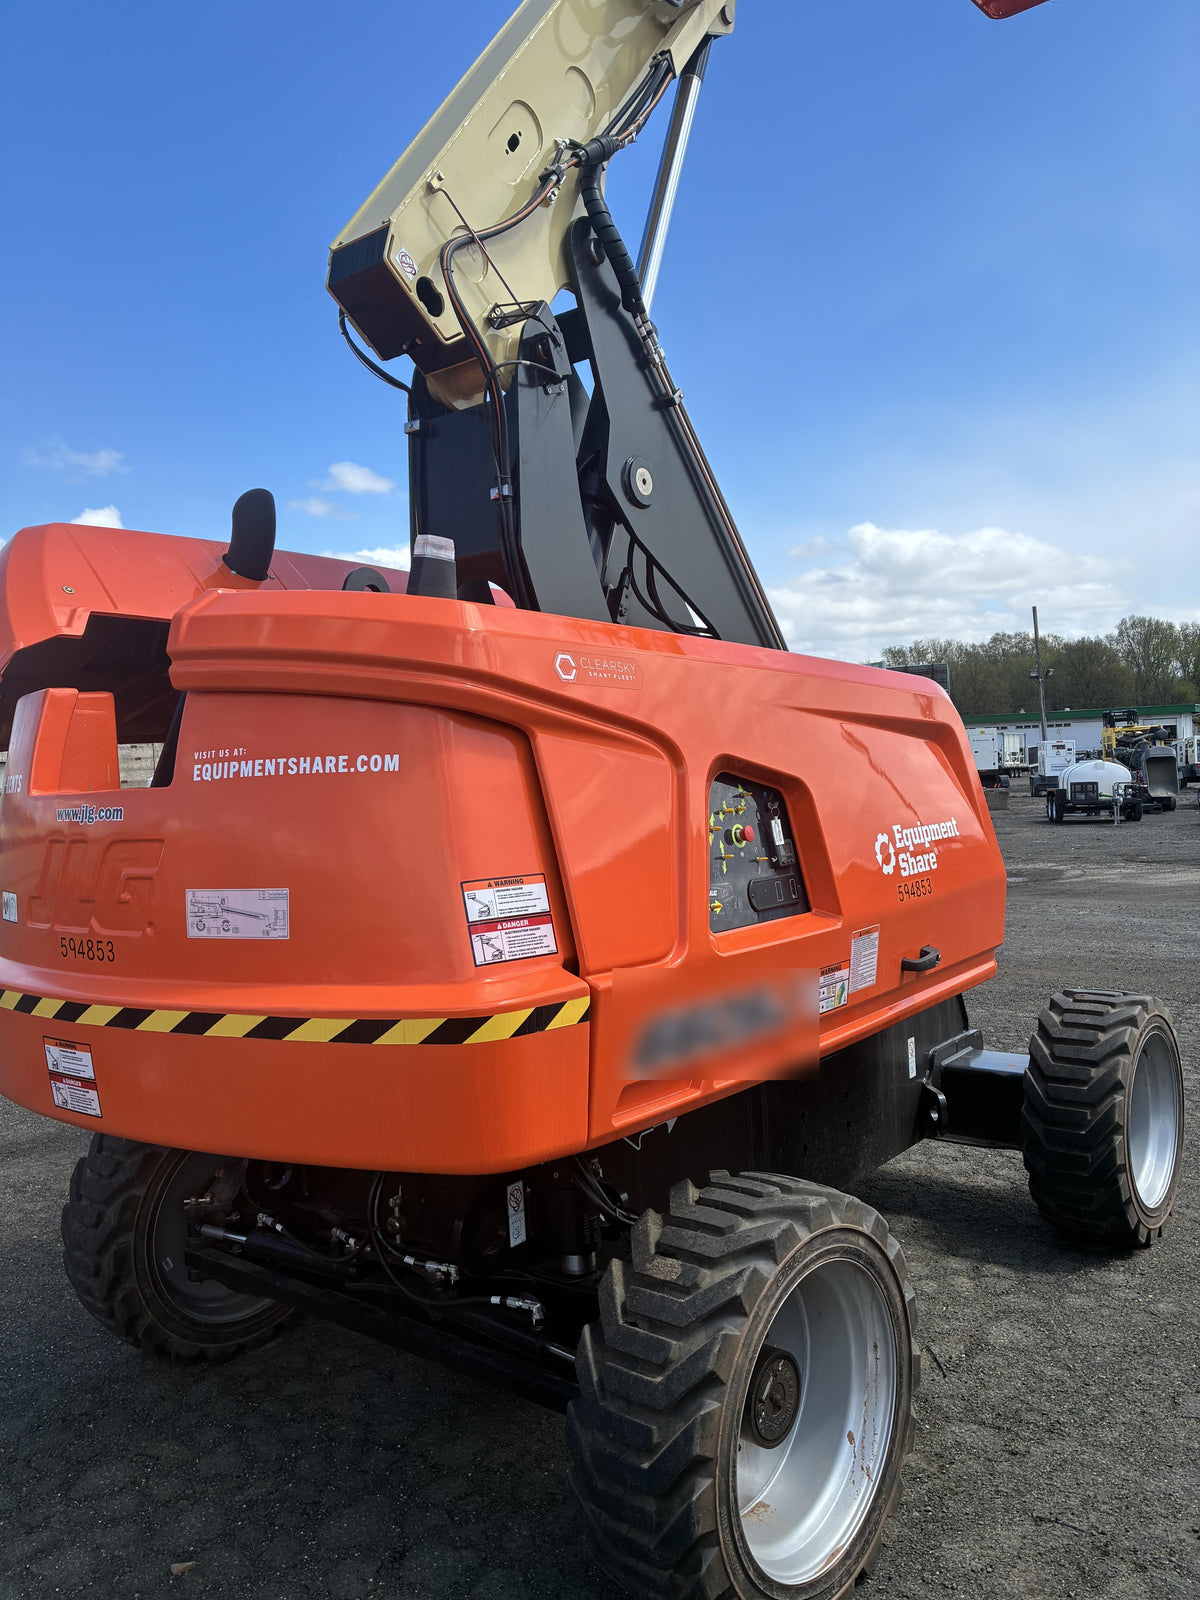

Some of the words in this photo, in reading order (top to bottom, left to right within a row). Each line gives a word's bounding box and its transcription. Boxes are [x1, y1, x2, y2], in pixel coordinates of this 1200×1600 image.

[579, 657, 636, 673] CLEARSKY
[194, 750, 216, 760] VISIT
[219, 749, 230, 757] US
[233, 747, 247, 757] AT:
[193, 754, 400, 781] EQUIPMENTSHARE.COM
[57, 804, 124, 825] www.jlg.com
[892, 816, 960, 851] Equipment
[898, 852, 938, 877] Share
[494, 878, 524, 887] WARNING
[897, 878, 933, 902] 594853
[502, 919, 529, 929] DANGER
[60, 937, 116, 962] 594853
[820, 964, 841, 976] WARNING
